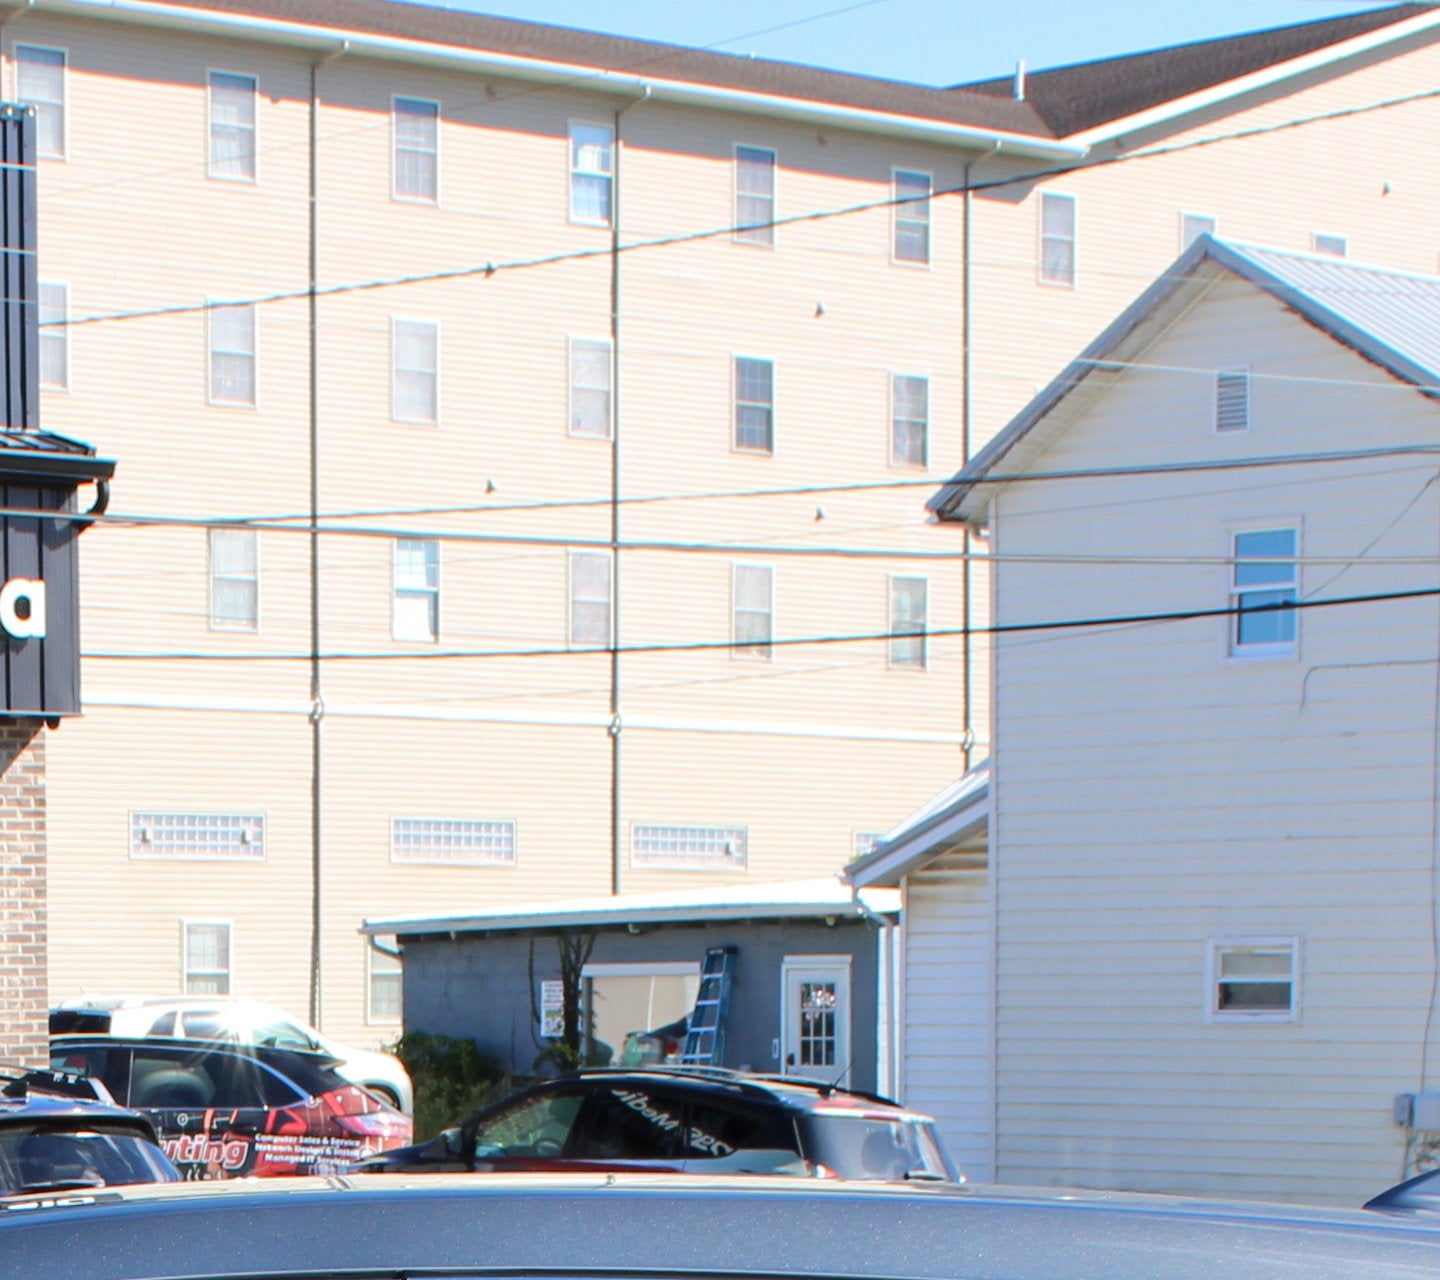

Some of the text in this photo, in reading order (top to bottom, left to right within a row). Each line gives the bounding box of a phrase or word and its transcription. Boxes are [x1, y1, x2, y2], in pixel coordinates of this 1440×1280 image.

[255, 1133, 297, 1144] Computer
[299, 1135, 320, 1144] Sales
[254, 1143, 292, 1152] Network
[265, 1153, 305, 1164] Managed
